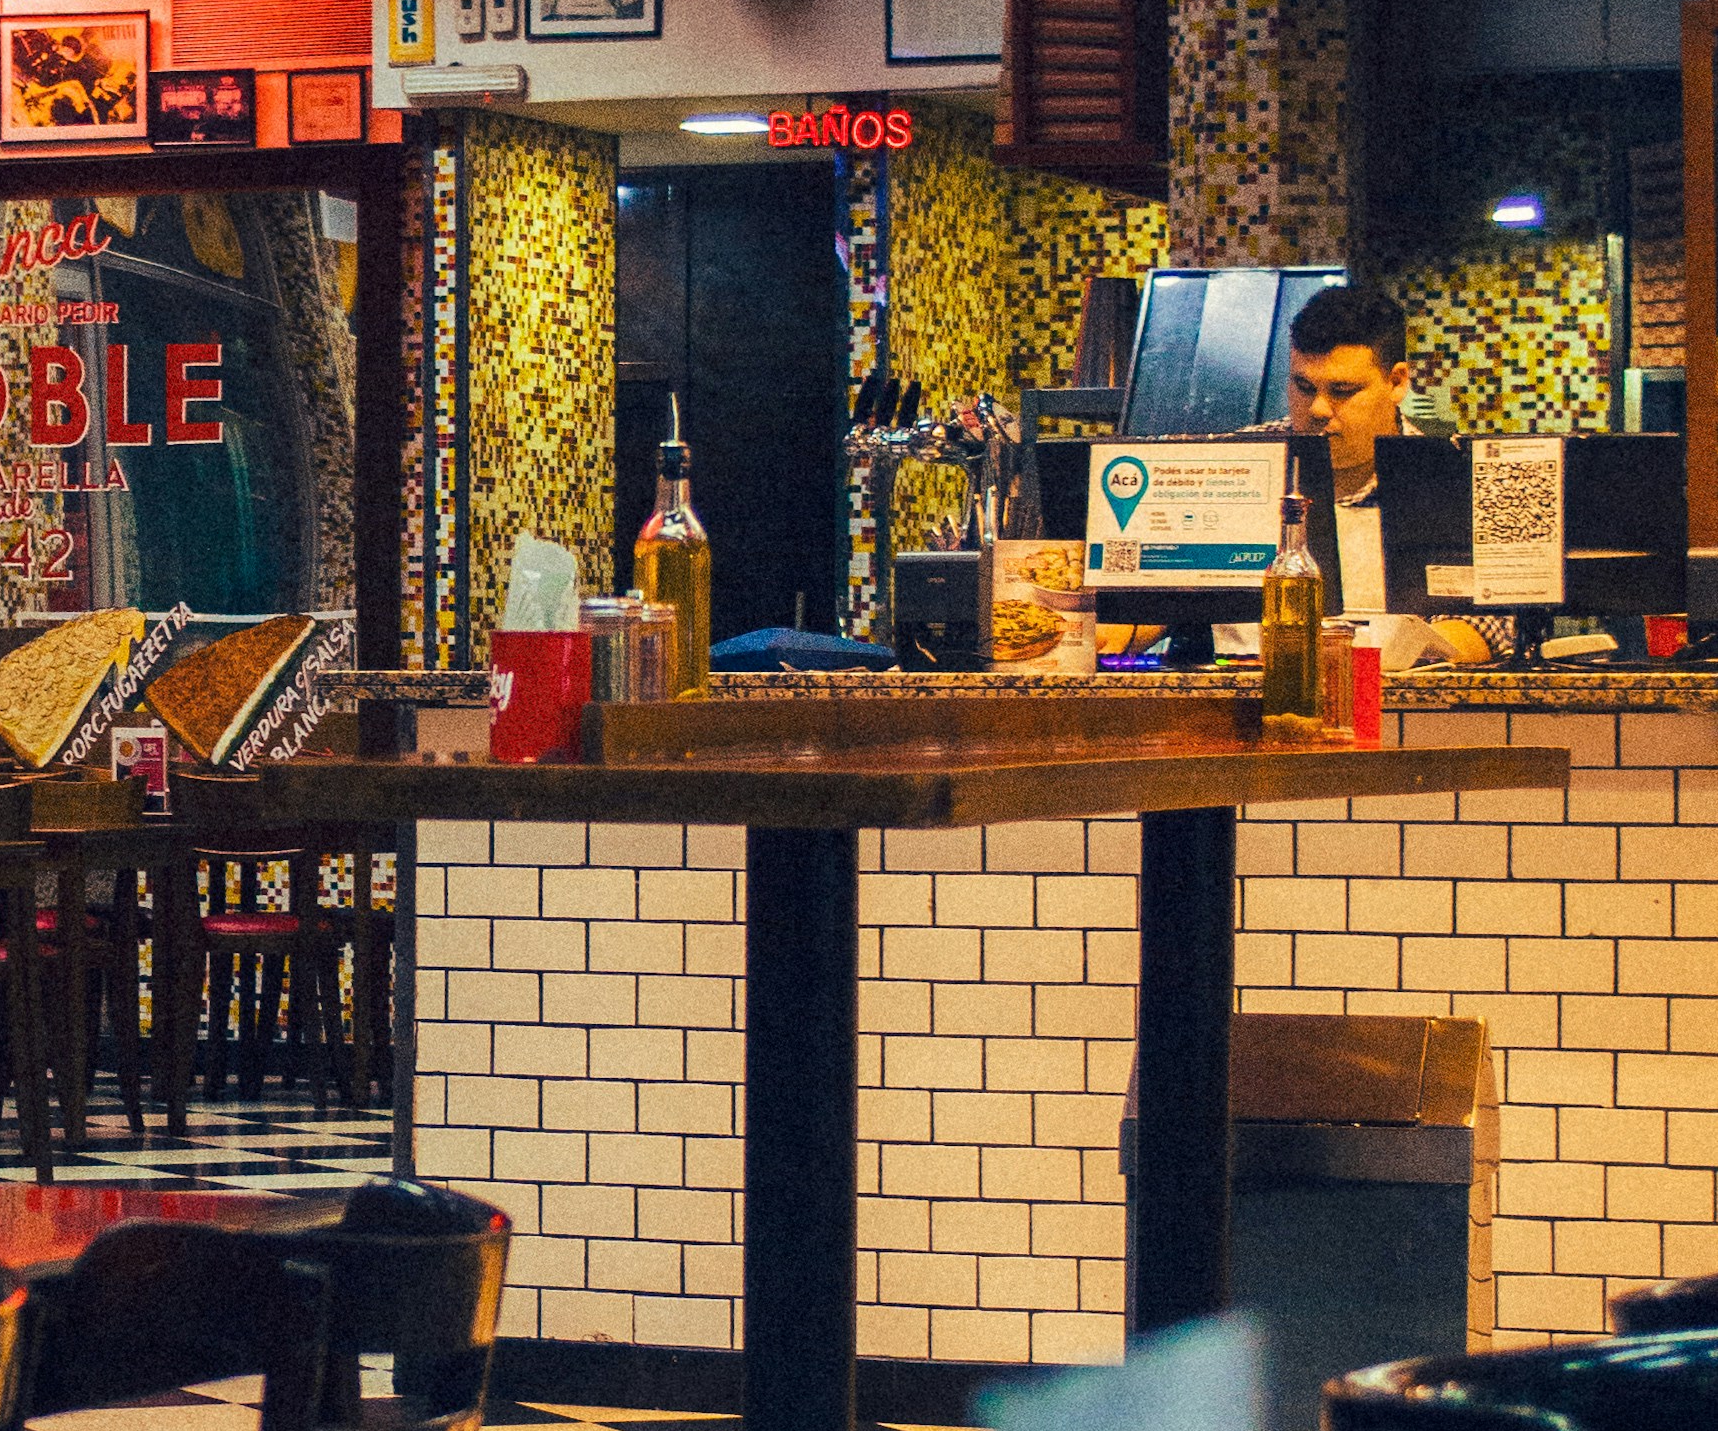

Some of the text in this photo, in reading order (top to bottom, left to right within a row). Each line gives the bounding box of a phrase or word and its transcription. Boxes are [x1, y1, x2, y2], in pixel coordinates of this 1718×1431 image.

[768, 104, 912, 149] BAÑOS
[57, 302, 119, 325] PEDIR
[1111, 472, 1138, 486] Acá
[229, 685, 300, 772] VERDURA
[270, 690, 331, 762] BLANC
